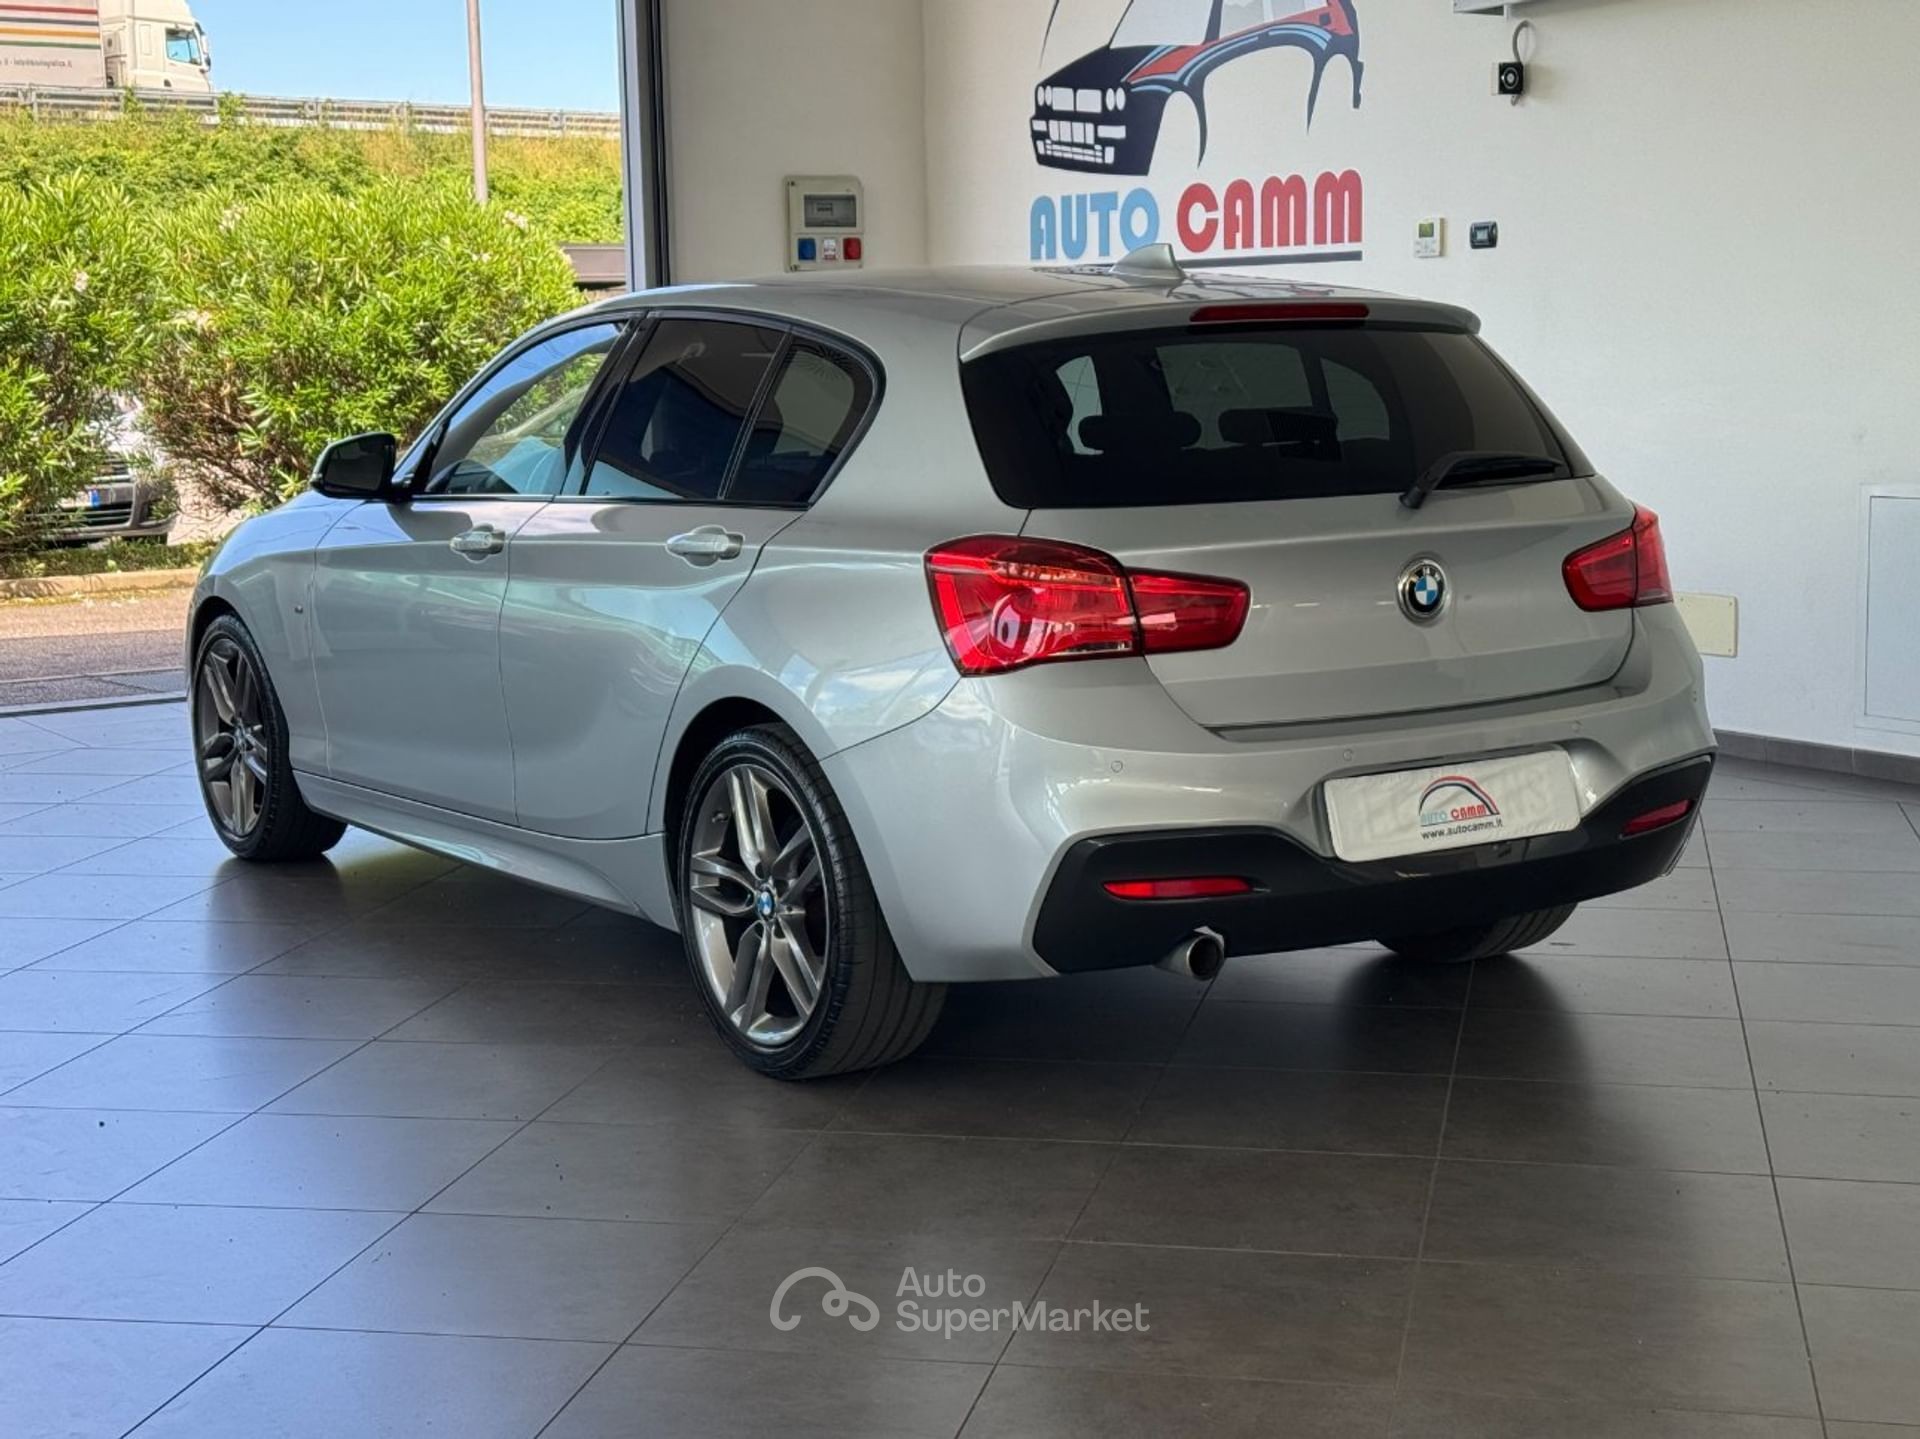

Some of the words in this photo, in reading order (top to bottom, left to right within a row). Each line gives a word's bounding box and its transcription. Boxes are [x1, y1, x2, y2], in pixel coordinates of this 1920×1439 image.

[1030, 187, 1160, 261] AUTO
[1176, 168, 1363, 254] CAMM
[1420, 810, 1448, 824] AUTO
[1450, 804, 1487, 820] CAMM
[1420, 817, 1503, 840] www.autocamm.it
